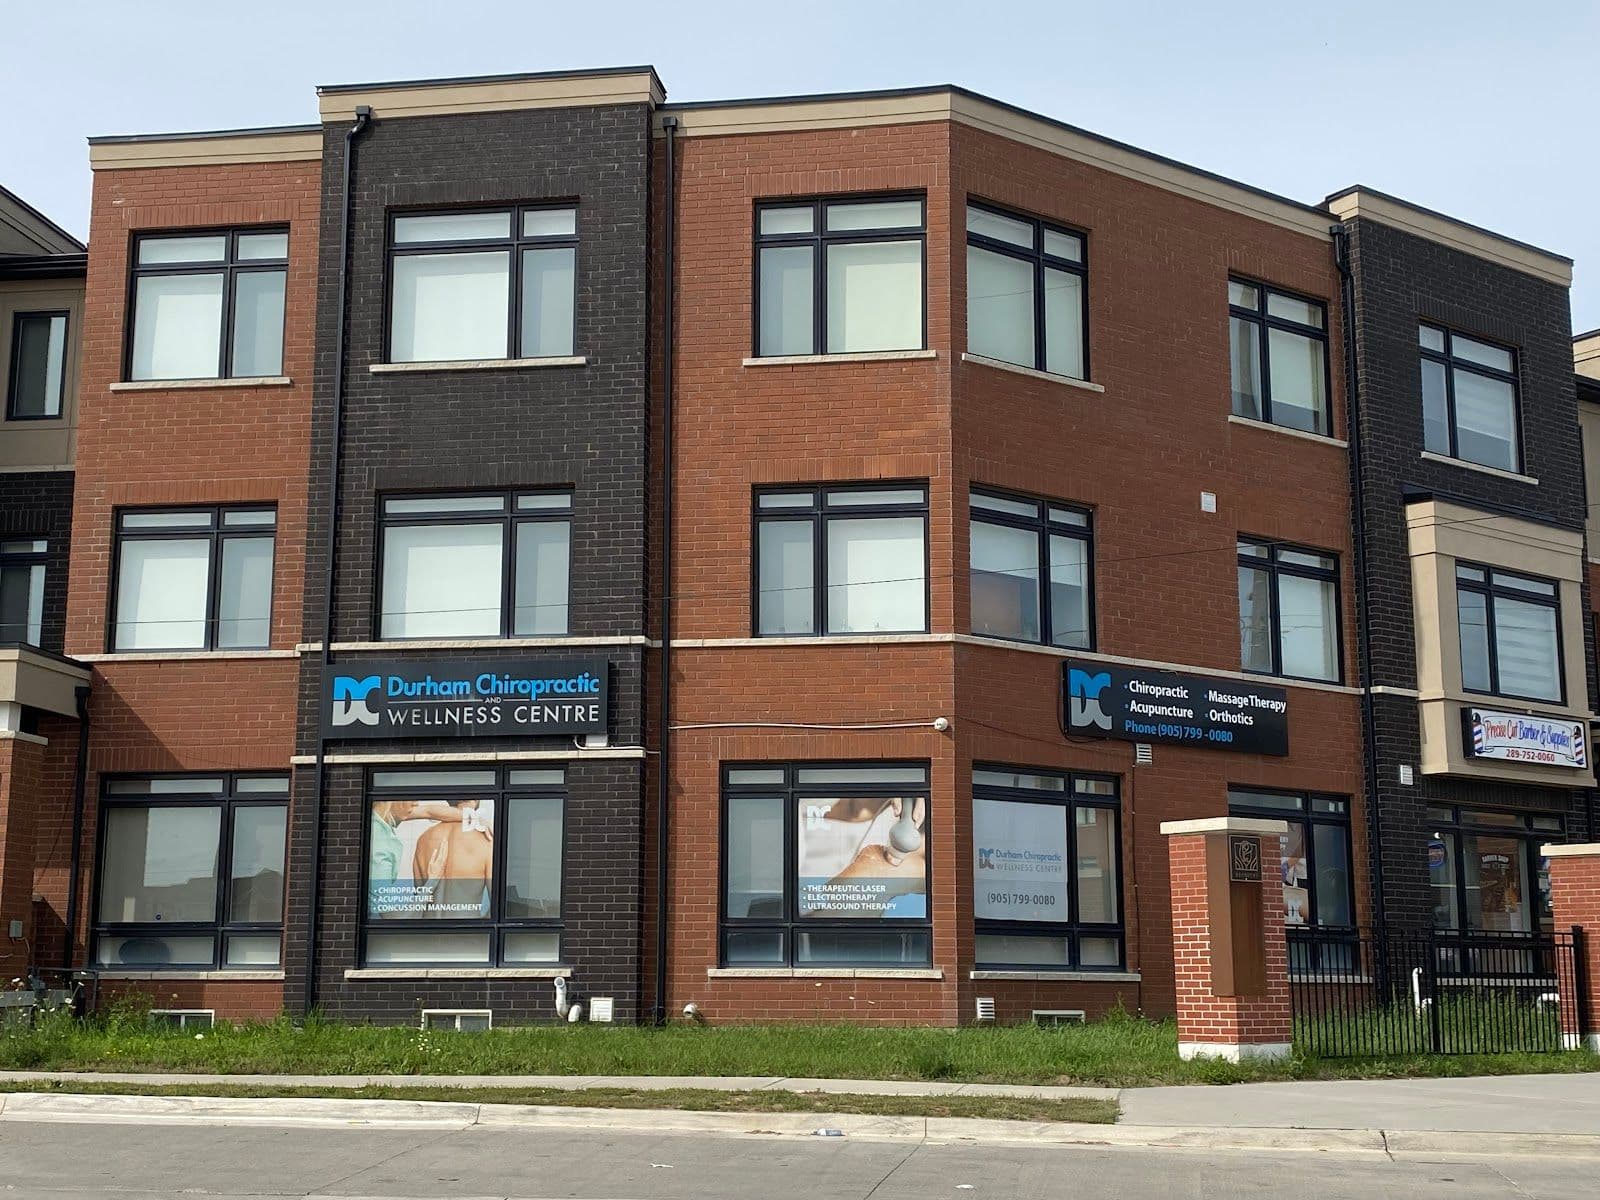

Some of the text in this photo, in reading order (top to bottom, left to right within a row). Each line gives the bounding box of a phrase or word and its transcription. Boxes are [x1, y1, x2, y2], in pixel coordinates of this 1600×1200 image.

[388, 672, 600, 701] Durham Chiropractic
[1129, 680, 1189, 699] Chiropractic
[1208, 690, 1287, 713] Massage Therapy
[388, 704, 599, 726] WELLNESS CENTRE
[1130, 700, 1194, 719] Acupuncture
[1209, 709, 1254, 726] Orthotics
[1125, 720, 1157, 735] Phone
[1158, 723, 1183, 739] (905)
[1484, 720, 1506, 739] Precise
[1507, 720, 1518, 739] Cut
[1519, 720, 1539, 740] Barber
[1547, 725, 1570, 750] Supplies
[996, 849, 1062, 862] Durham Chiropractic
[996, 863, 1062, 873] WELLNESS CENTRE
[378, 886, 433, 894] CHIROPRACTIC
[807, 893, 877, 901] ELECTROTHERAPY
[378, 895, 434, 903] ACUPUNCTURE
[807, 902, 897, 910] ULTRASOUND THERAPY
[987, 893, 1055, 905] (905) 799-0080
[377, 903, 482, 912] CONCUSSION MANAGEMENT
